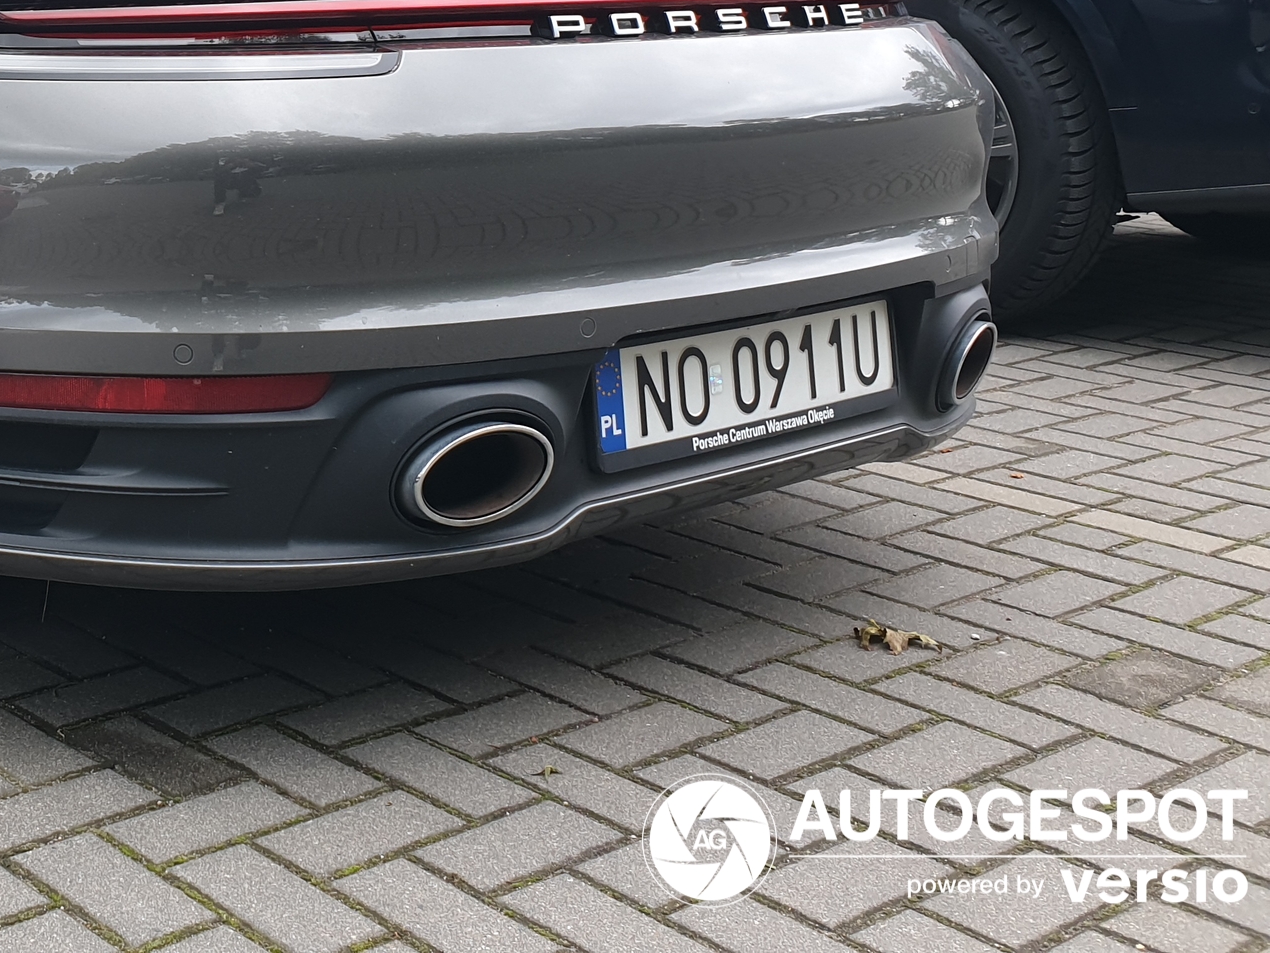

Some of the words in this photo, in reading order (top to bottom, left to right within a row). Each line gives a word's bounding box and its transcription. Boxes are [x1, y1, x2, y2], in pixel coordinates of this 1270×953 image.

[547, 3, 864, 38] PORSCHE
[635, 346, 710, 438] NO
[732, 310, 880, 414] 0911U
[601, 415, 622, 438] PL
[692, 431, 729, 451] Porsche
[730, 424, 767, 443] Centrum
[766, 414, 808, 434] Warszawa
[808, 406, 835, 424] Okęcie
